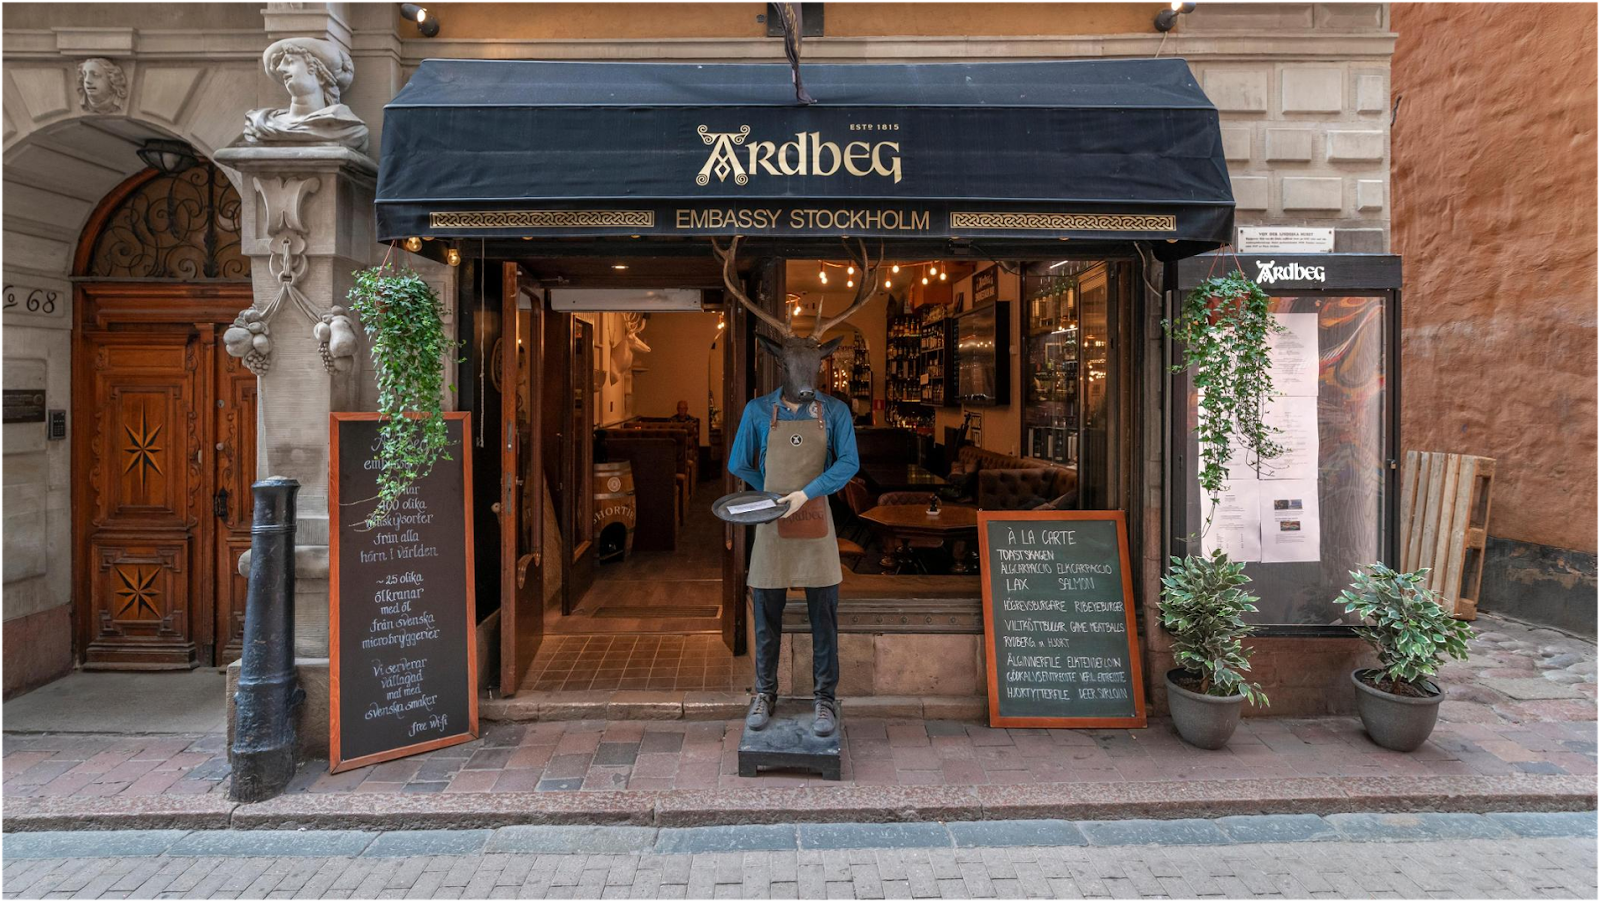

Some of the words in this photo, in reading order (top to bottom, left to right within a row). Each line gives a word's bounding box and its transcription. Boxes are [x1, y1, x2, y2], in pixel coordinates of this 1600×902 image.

[877, 123, 899, 131] 1815
[676, 209, 782, 229] EMBASSY
[790, 209, 931, 230] STOCKHOLM
[26, 289, 57, 314] 68
[402, 497, 427, 513] olika
[401, 529, 419, 543] alla
[1021, 530, 1035, 545] LA
[1042, 530, 1077, 545] CARTE
[400, 571, 424, 585] olika
[1006, 578, 1029, 593] LAX
[1058, 577, 1095, 591] SALMON
[380, 602, 400, 615] med
[396, 611, 435, 629] svenska
[1089, 621, 1125, 633] MEATBALLS
[386, 658, 427, 675] serverar
[404, 683, 422, 697] med
[365, 701, 405, 720] svenska
[409, 722, 428, 737] free
